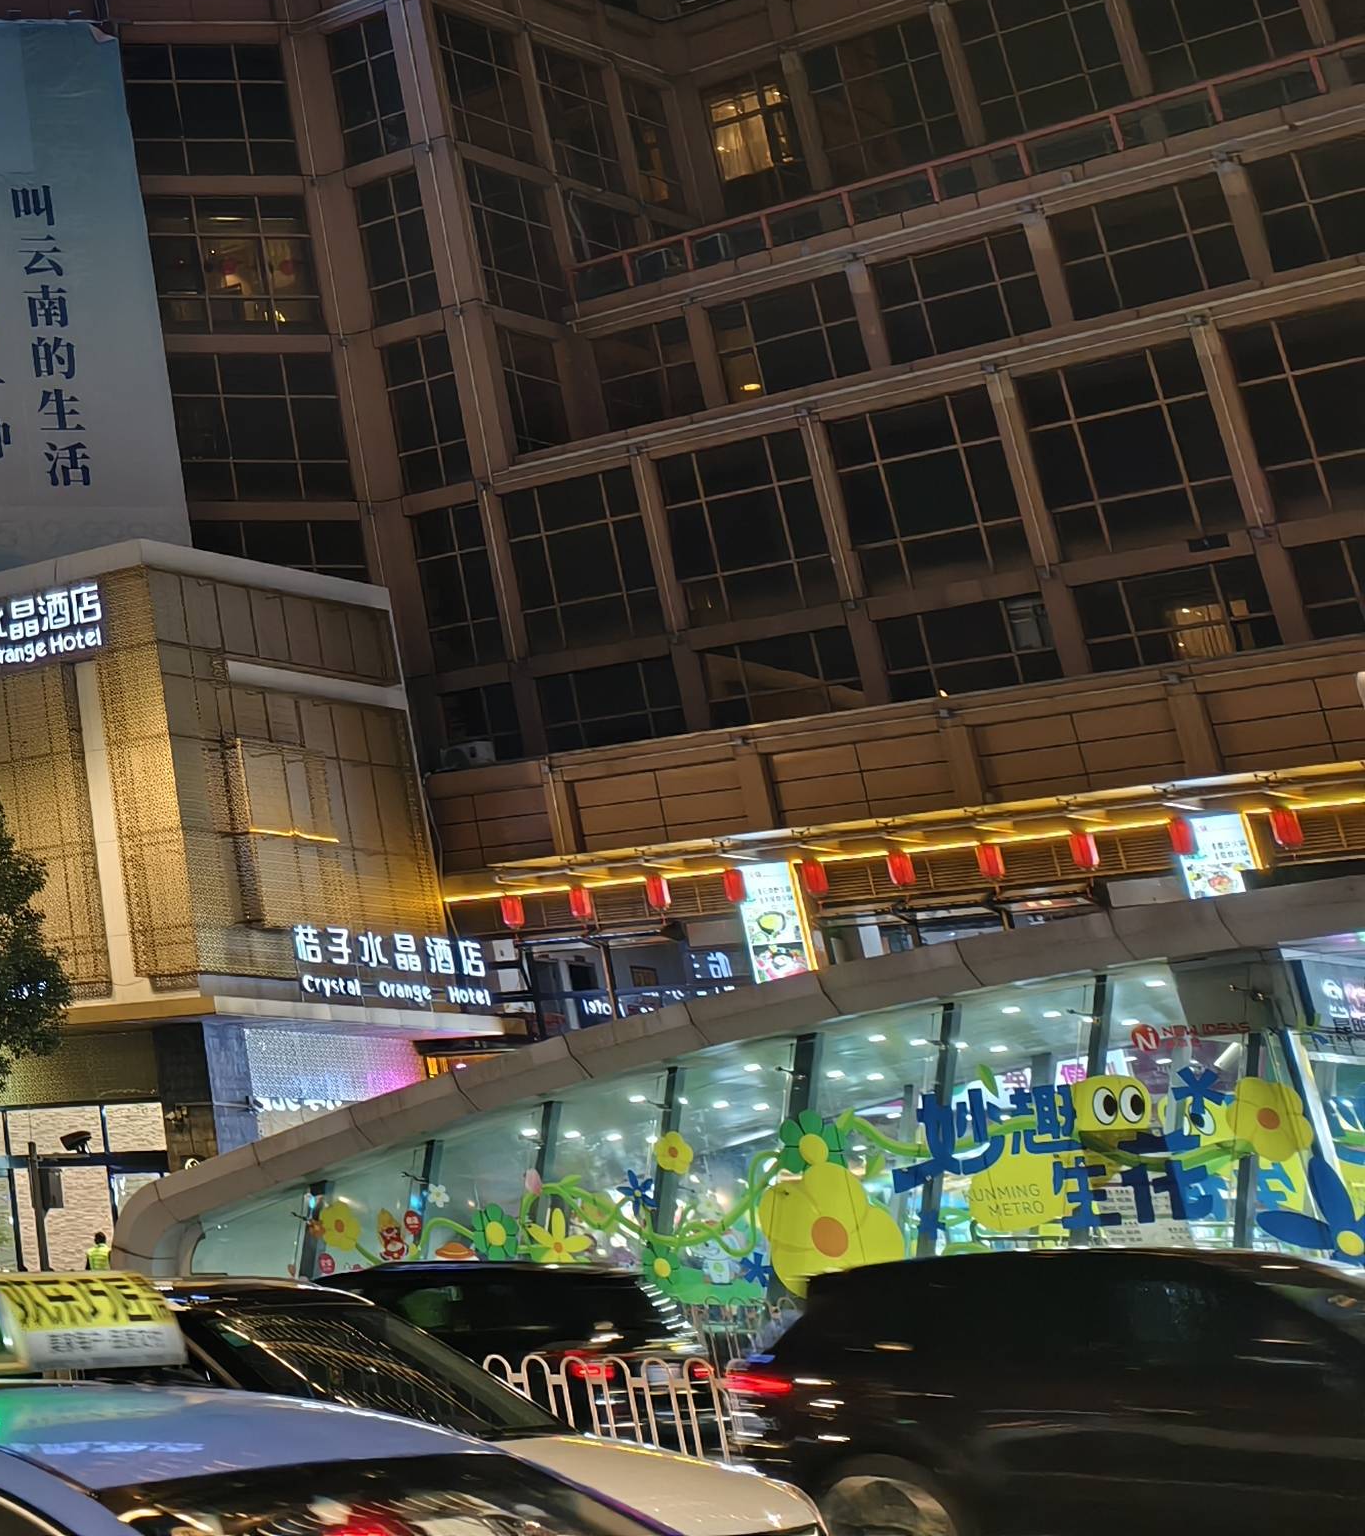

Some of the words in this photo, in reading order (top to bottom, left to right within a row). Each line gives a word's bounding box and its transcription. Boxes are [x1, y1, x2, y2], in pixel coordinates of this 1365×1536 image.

[10, 184, 93, 488] 叫云南的生活
[50, 627, 102, 655] Hotel
[293, 924, 487, 978] 桔子水晶酒店
[302, 974, 363, 999] Crystal
[378, 980, 433, 1002] Orange
[447, 986, 492, 1007] Hotel
[963, 1183, 1041, 1203] KUNMING
[987, 1200, 1046, 1218] METRO
